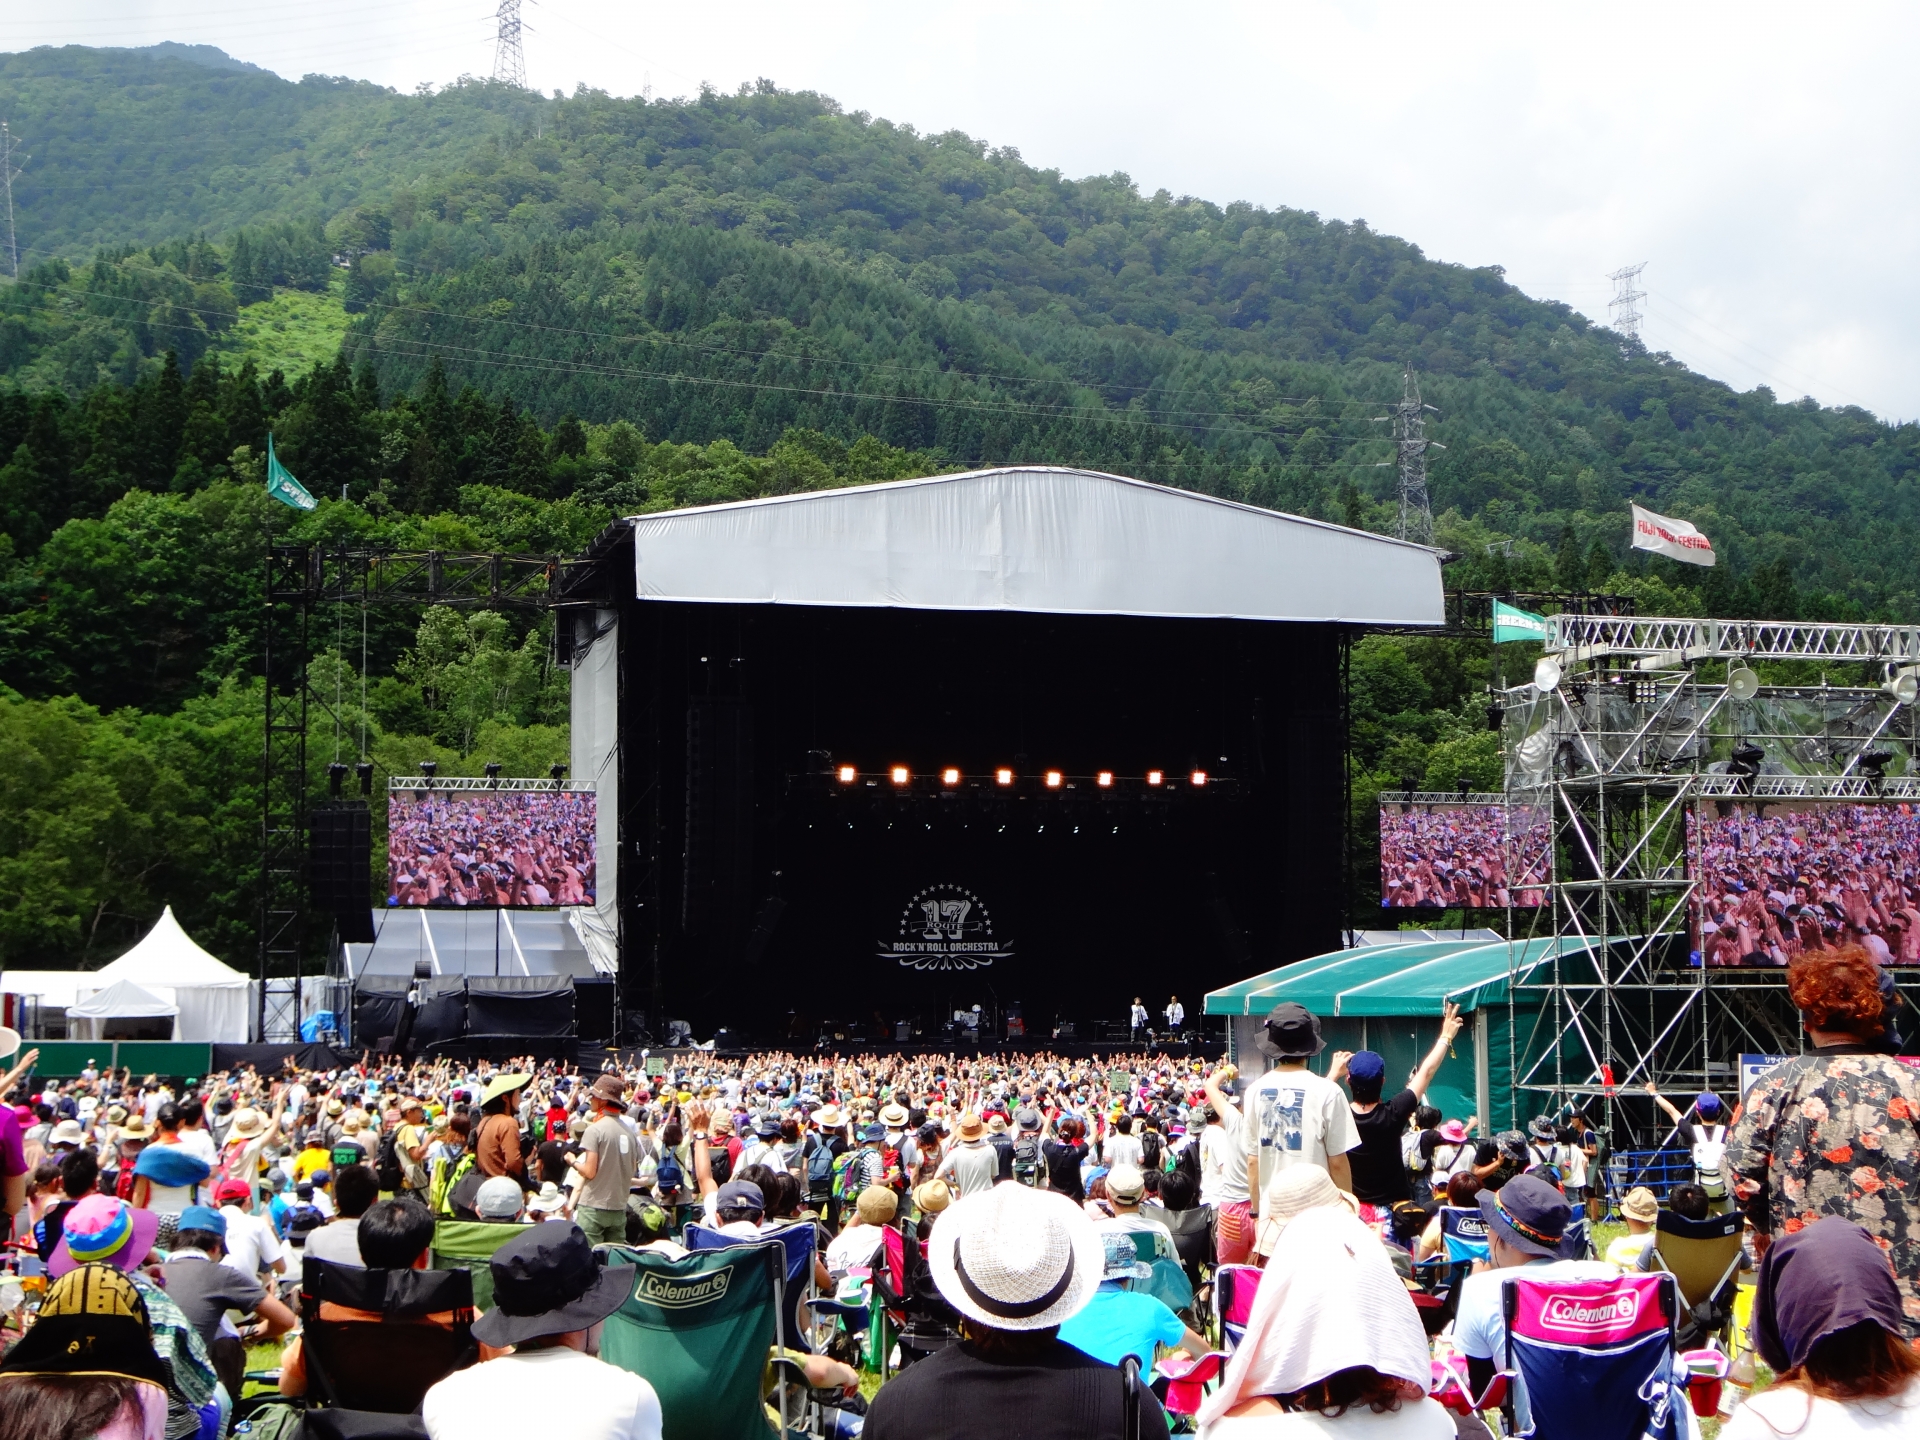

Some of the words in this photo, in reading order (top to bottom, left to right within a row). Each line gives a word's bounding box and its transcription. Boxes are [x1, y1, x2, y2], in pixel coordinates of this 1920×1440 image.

[1637, 520, 1656, 536] FUJI
[921, 900, 971, 939] 17
[927, 921, 963, 930] ROUTE
[950, 942, 998, 951] ORCHESTRA
[646, 1277, 711, 1300] Coleman
[1551, 1299, 1617, 1322] Coleman
